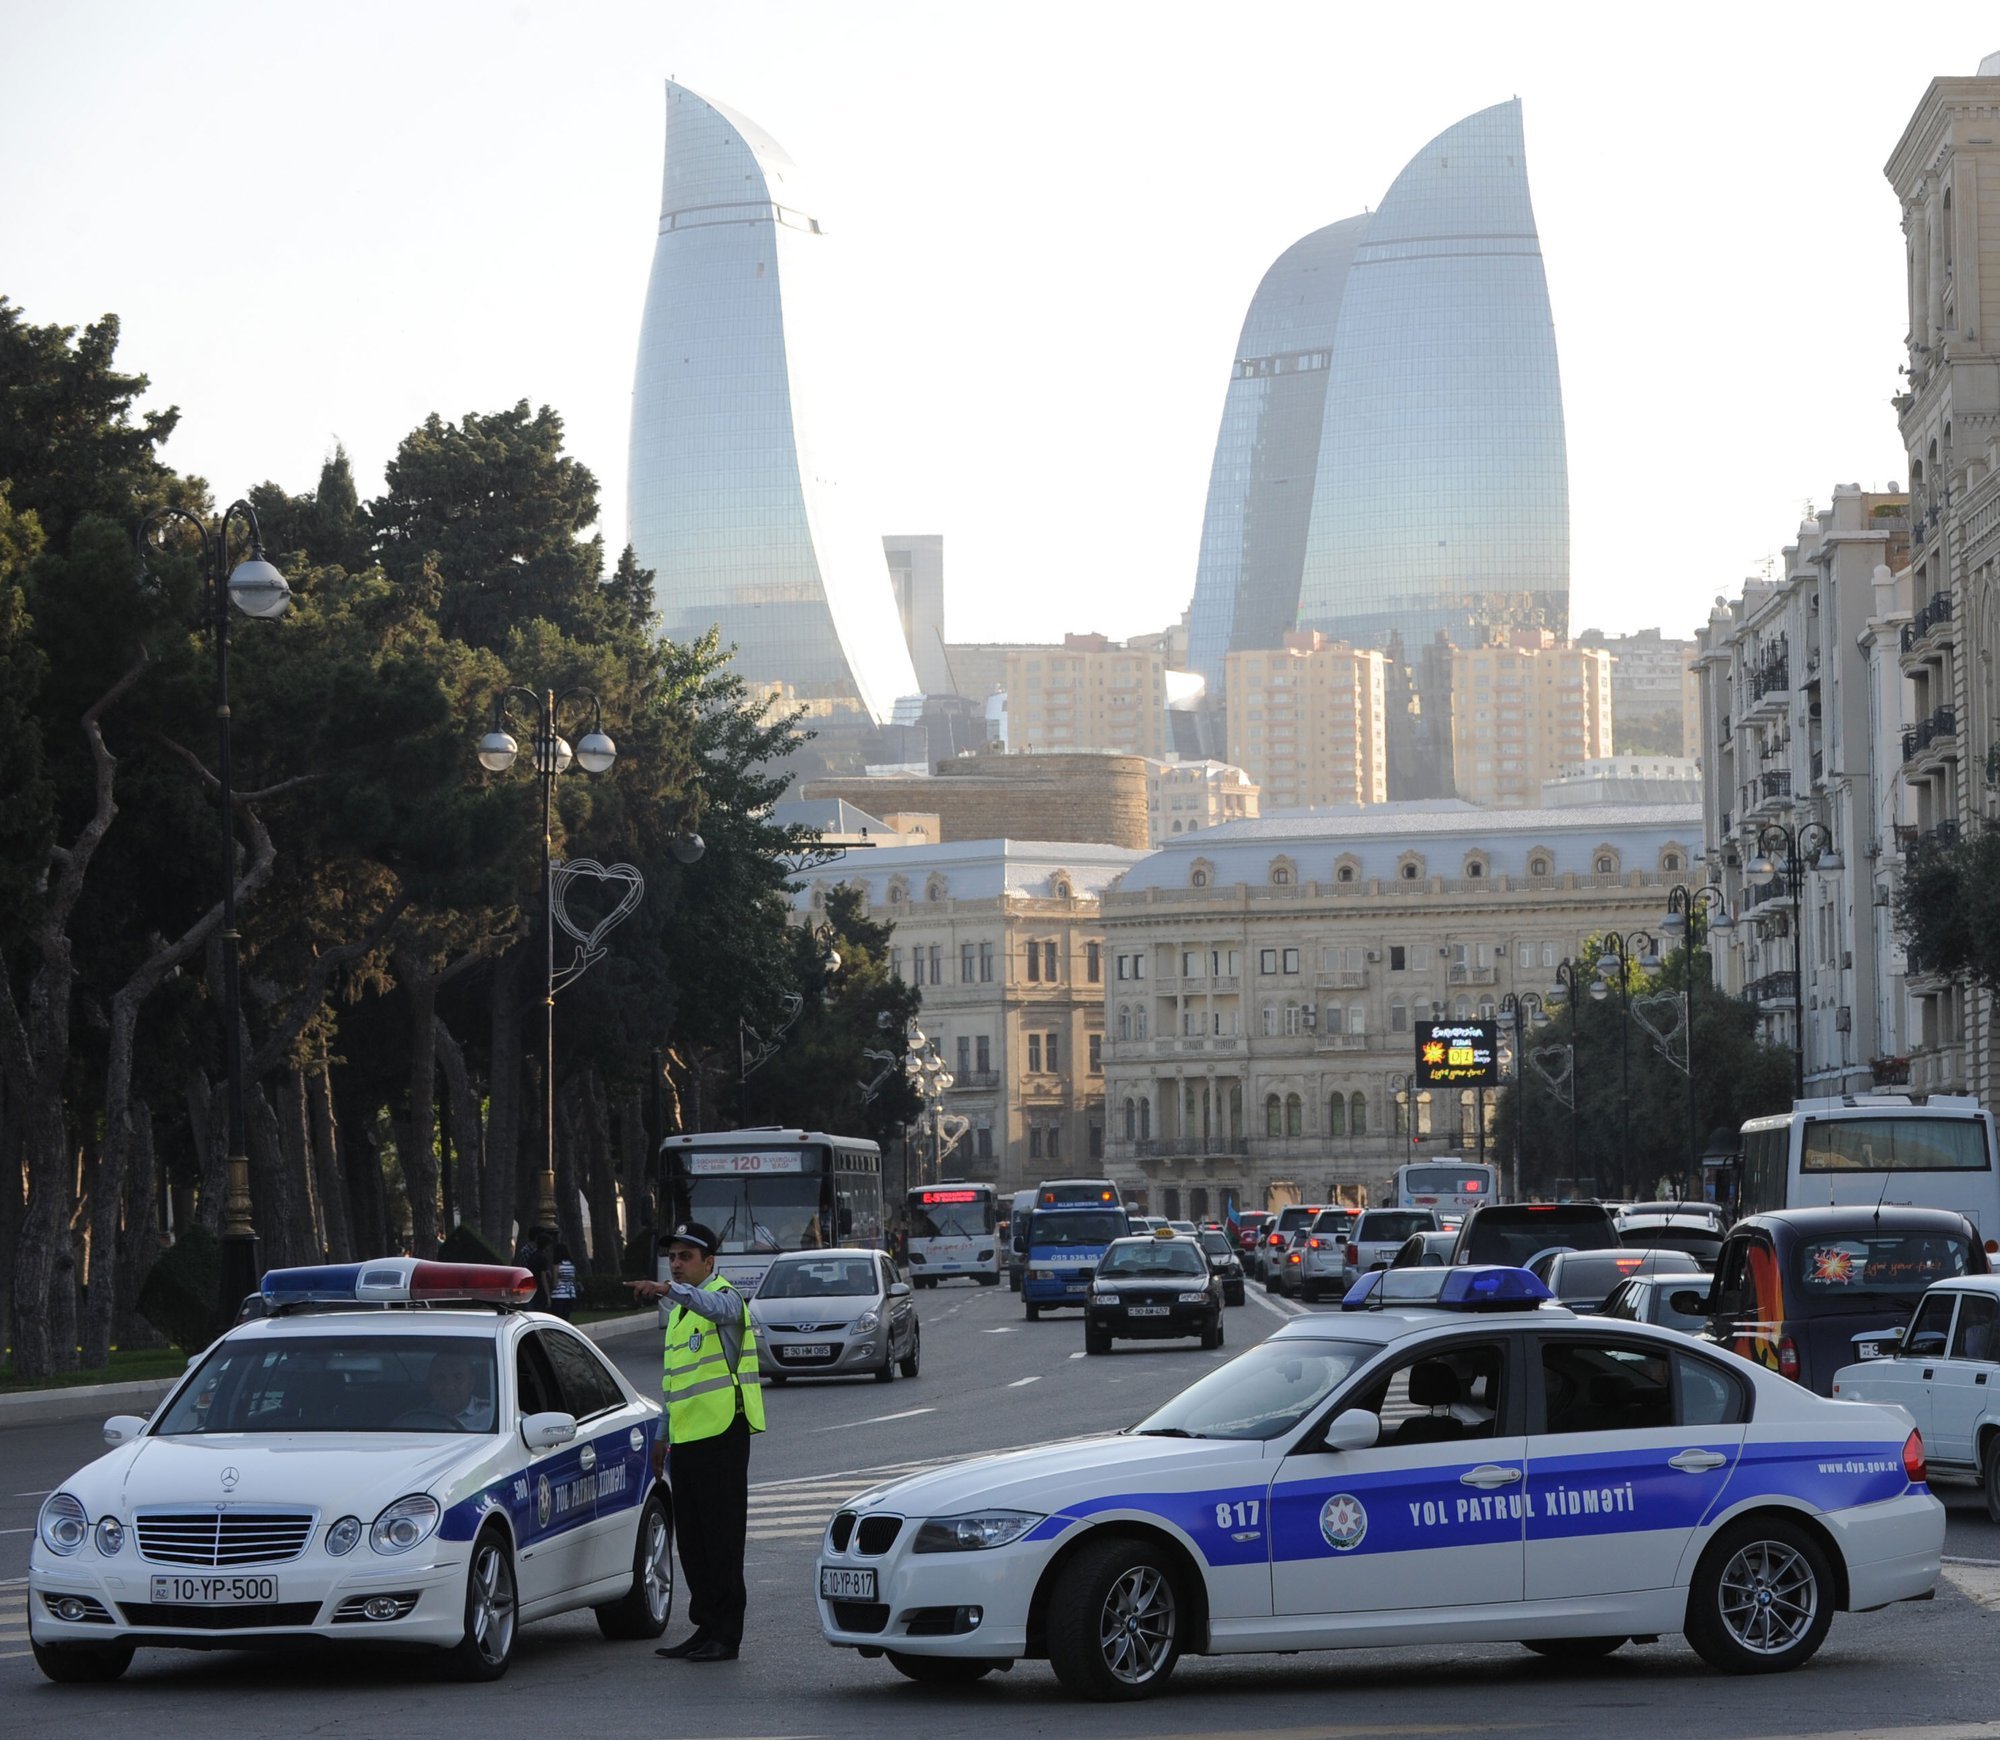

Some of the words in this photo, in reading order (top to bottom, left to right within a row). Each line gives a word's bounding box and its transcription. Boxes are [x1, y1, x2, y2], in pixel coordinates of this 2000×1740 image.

[731, 1156, 760, 1170] 120
[1818, 1461, 1898, 1473] www.dyp.gov.az
[514, 1478, 528, 1500] 500
[555, 1484, 569, 1513] YOL
[571, 1475, 597, 1507] PATRUL
[1215, 1501, 1260, 1528] 817
[1409, 1500, 1448, 1527] YOL
[1456, 1494, 1535, 1523] PATRUL
[1545, 1482, 1634, 1517] XİDMƏTİ
[173, 1579, 272, 1600] 10-YP-500
[830, 1571, 873, 1595] 10-YP-817
